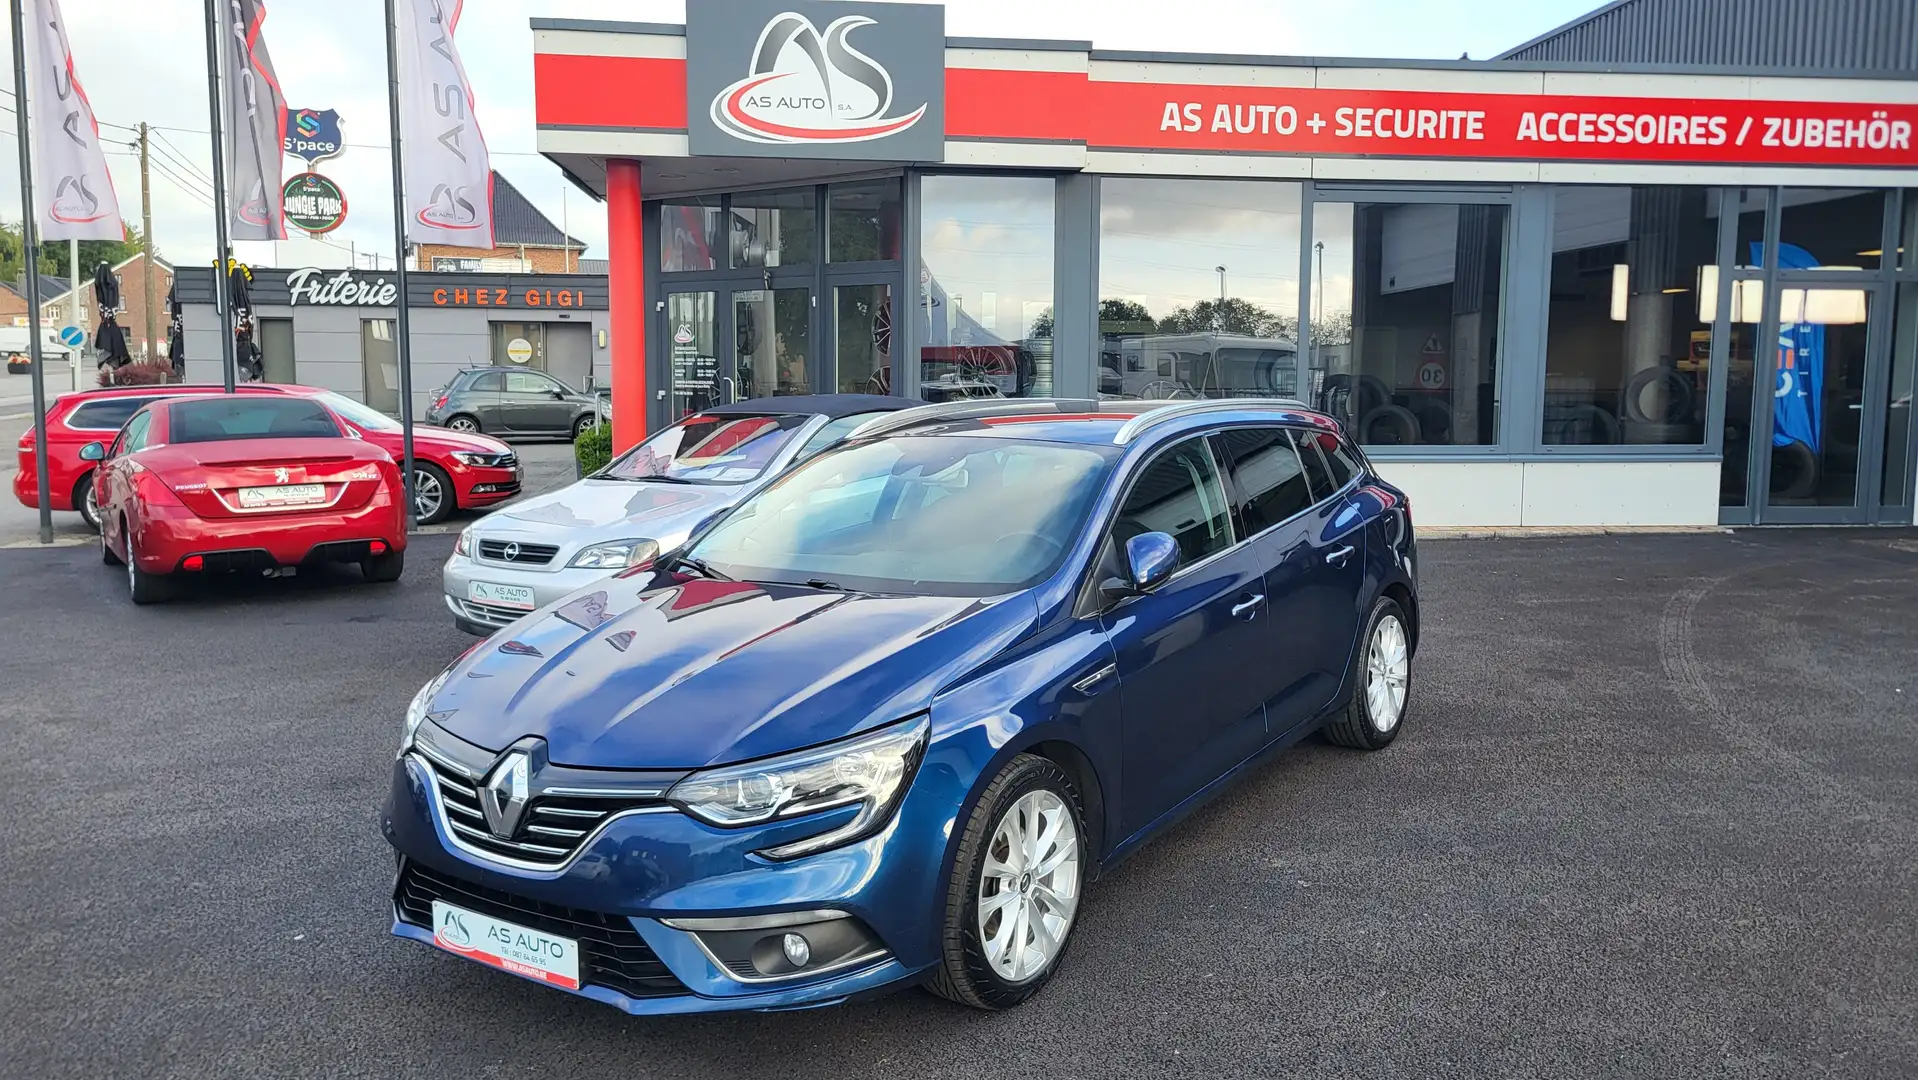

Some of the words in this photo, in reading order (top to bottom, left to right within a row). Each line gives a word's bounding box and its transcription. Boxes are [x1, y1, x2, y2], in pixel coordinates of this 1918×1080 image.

[745, 96, 771, 108] AS
[776, 97, 825, 110] AUTO
[1160, 102, 1202, 132] AS
[1211, 104, 1297, 135] AUTO
[1305, 112, 1327, 134] +
[1334, 107, 1485, 140] SECURITE
[1516, 111, 1727, 146] ACCESSOIRES
[1735, 116, 1753, 146] /
[1762, 111, 1912, 150] ZUBEHÖR
[283, 137, 335, 152] S'pace
[283, 195, 317, 216] JUNGLE
[318, 196, 342, 216] PARK
[286, 267, 398, 307] Friterie
[433, 288, 508, 306] CHEZ
[525, 289, 584, 307] GIGI
[495, 587, 505, 595] AS
[507, 588, 528, 597] AUTO
[487, 925, 511, 944] AS
[516, 933, 564, 959] AUTO
